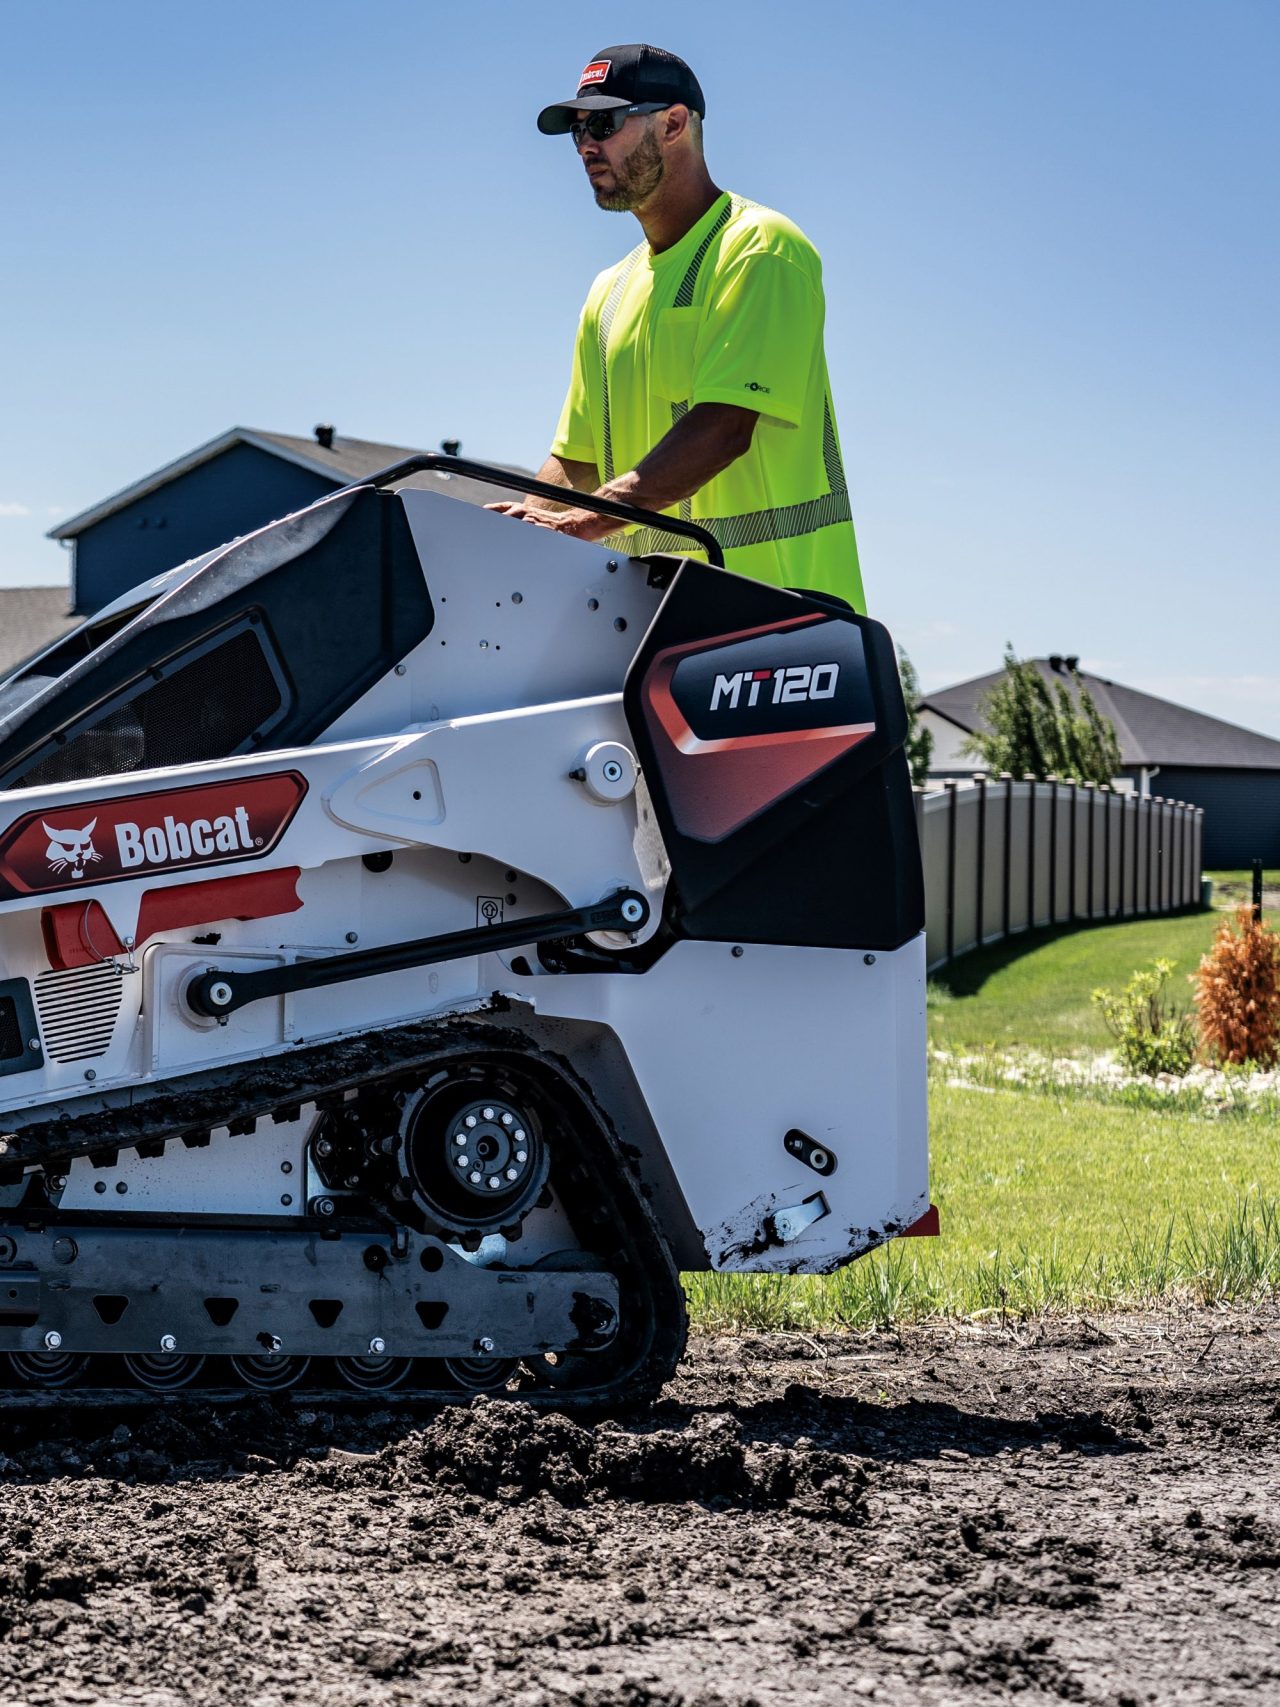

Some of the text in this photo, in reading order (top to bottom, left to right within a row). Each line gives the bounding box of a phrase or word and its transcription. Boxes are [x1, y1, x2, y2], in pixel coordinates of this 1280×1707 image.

[744, 382, 771, 394] FORCE
[709, 662, 840, 711] MT120
[114, 806, 254, 868] Bobcat
